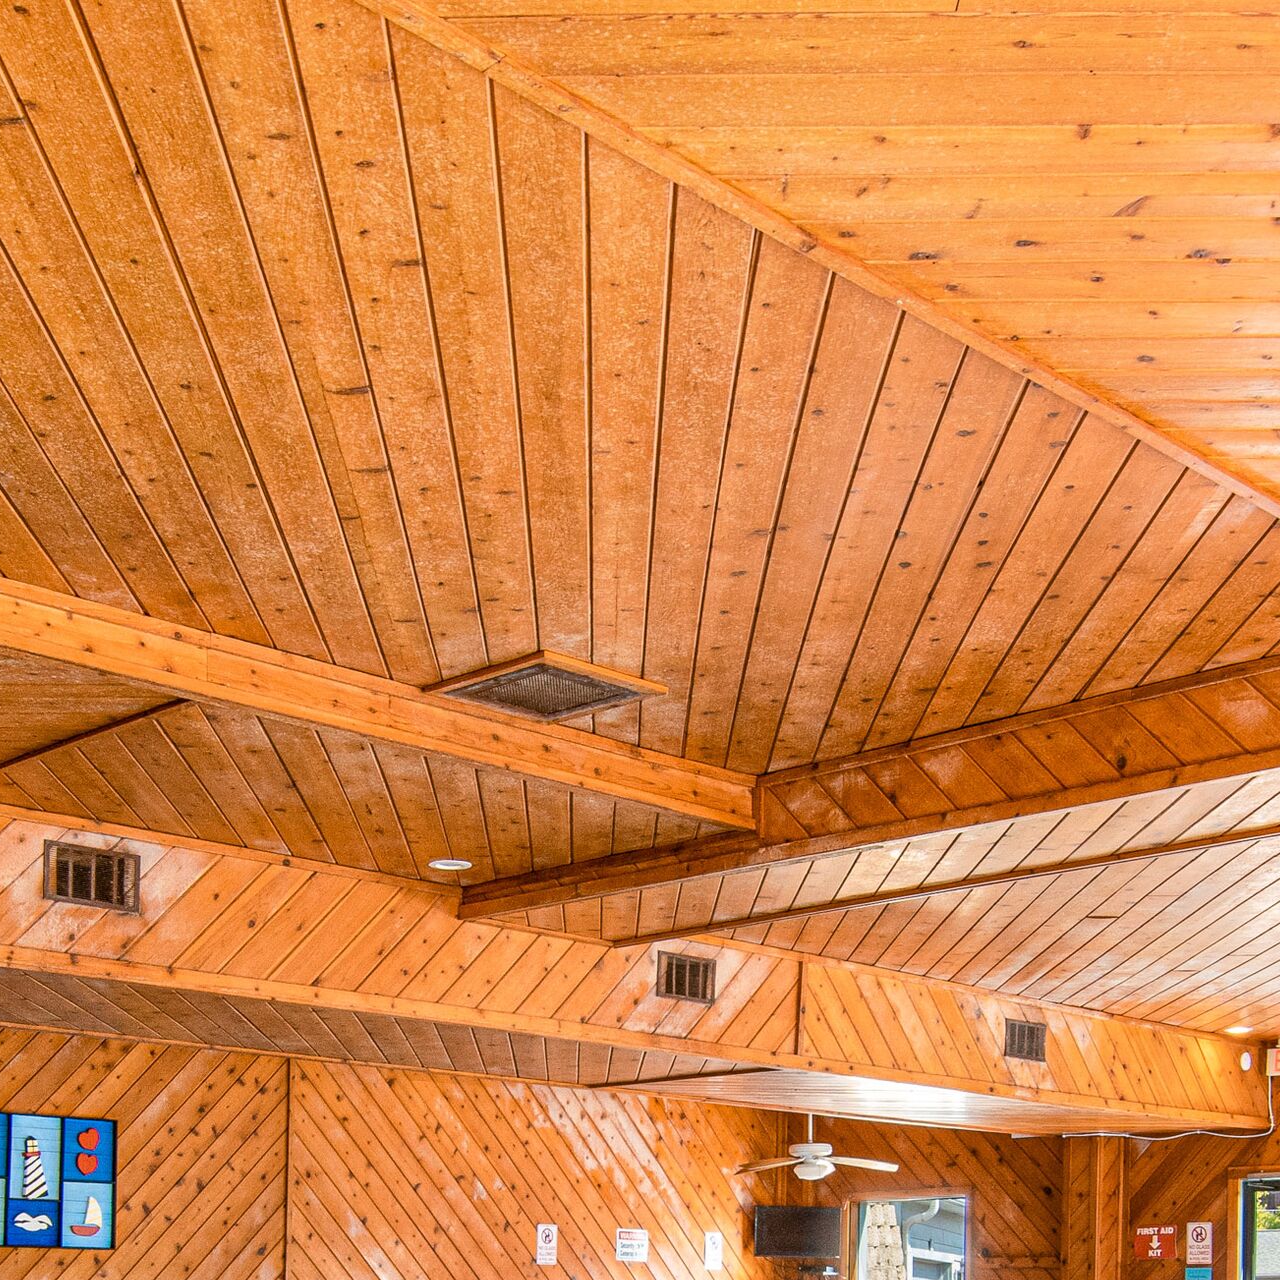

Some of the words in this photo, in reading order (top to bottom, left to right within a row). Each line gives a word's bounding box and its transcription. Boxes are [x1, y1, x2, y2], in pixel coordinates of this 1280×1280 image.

[1136, 1227, 1159, 1236] FIRST
[1160, 1227, 1174, 1235] AID
[1148, 1249, 1162, 1257] KIT
